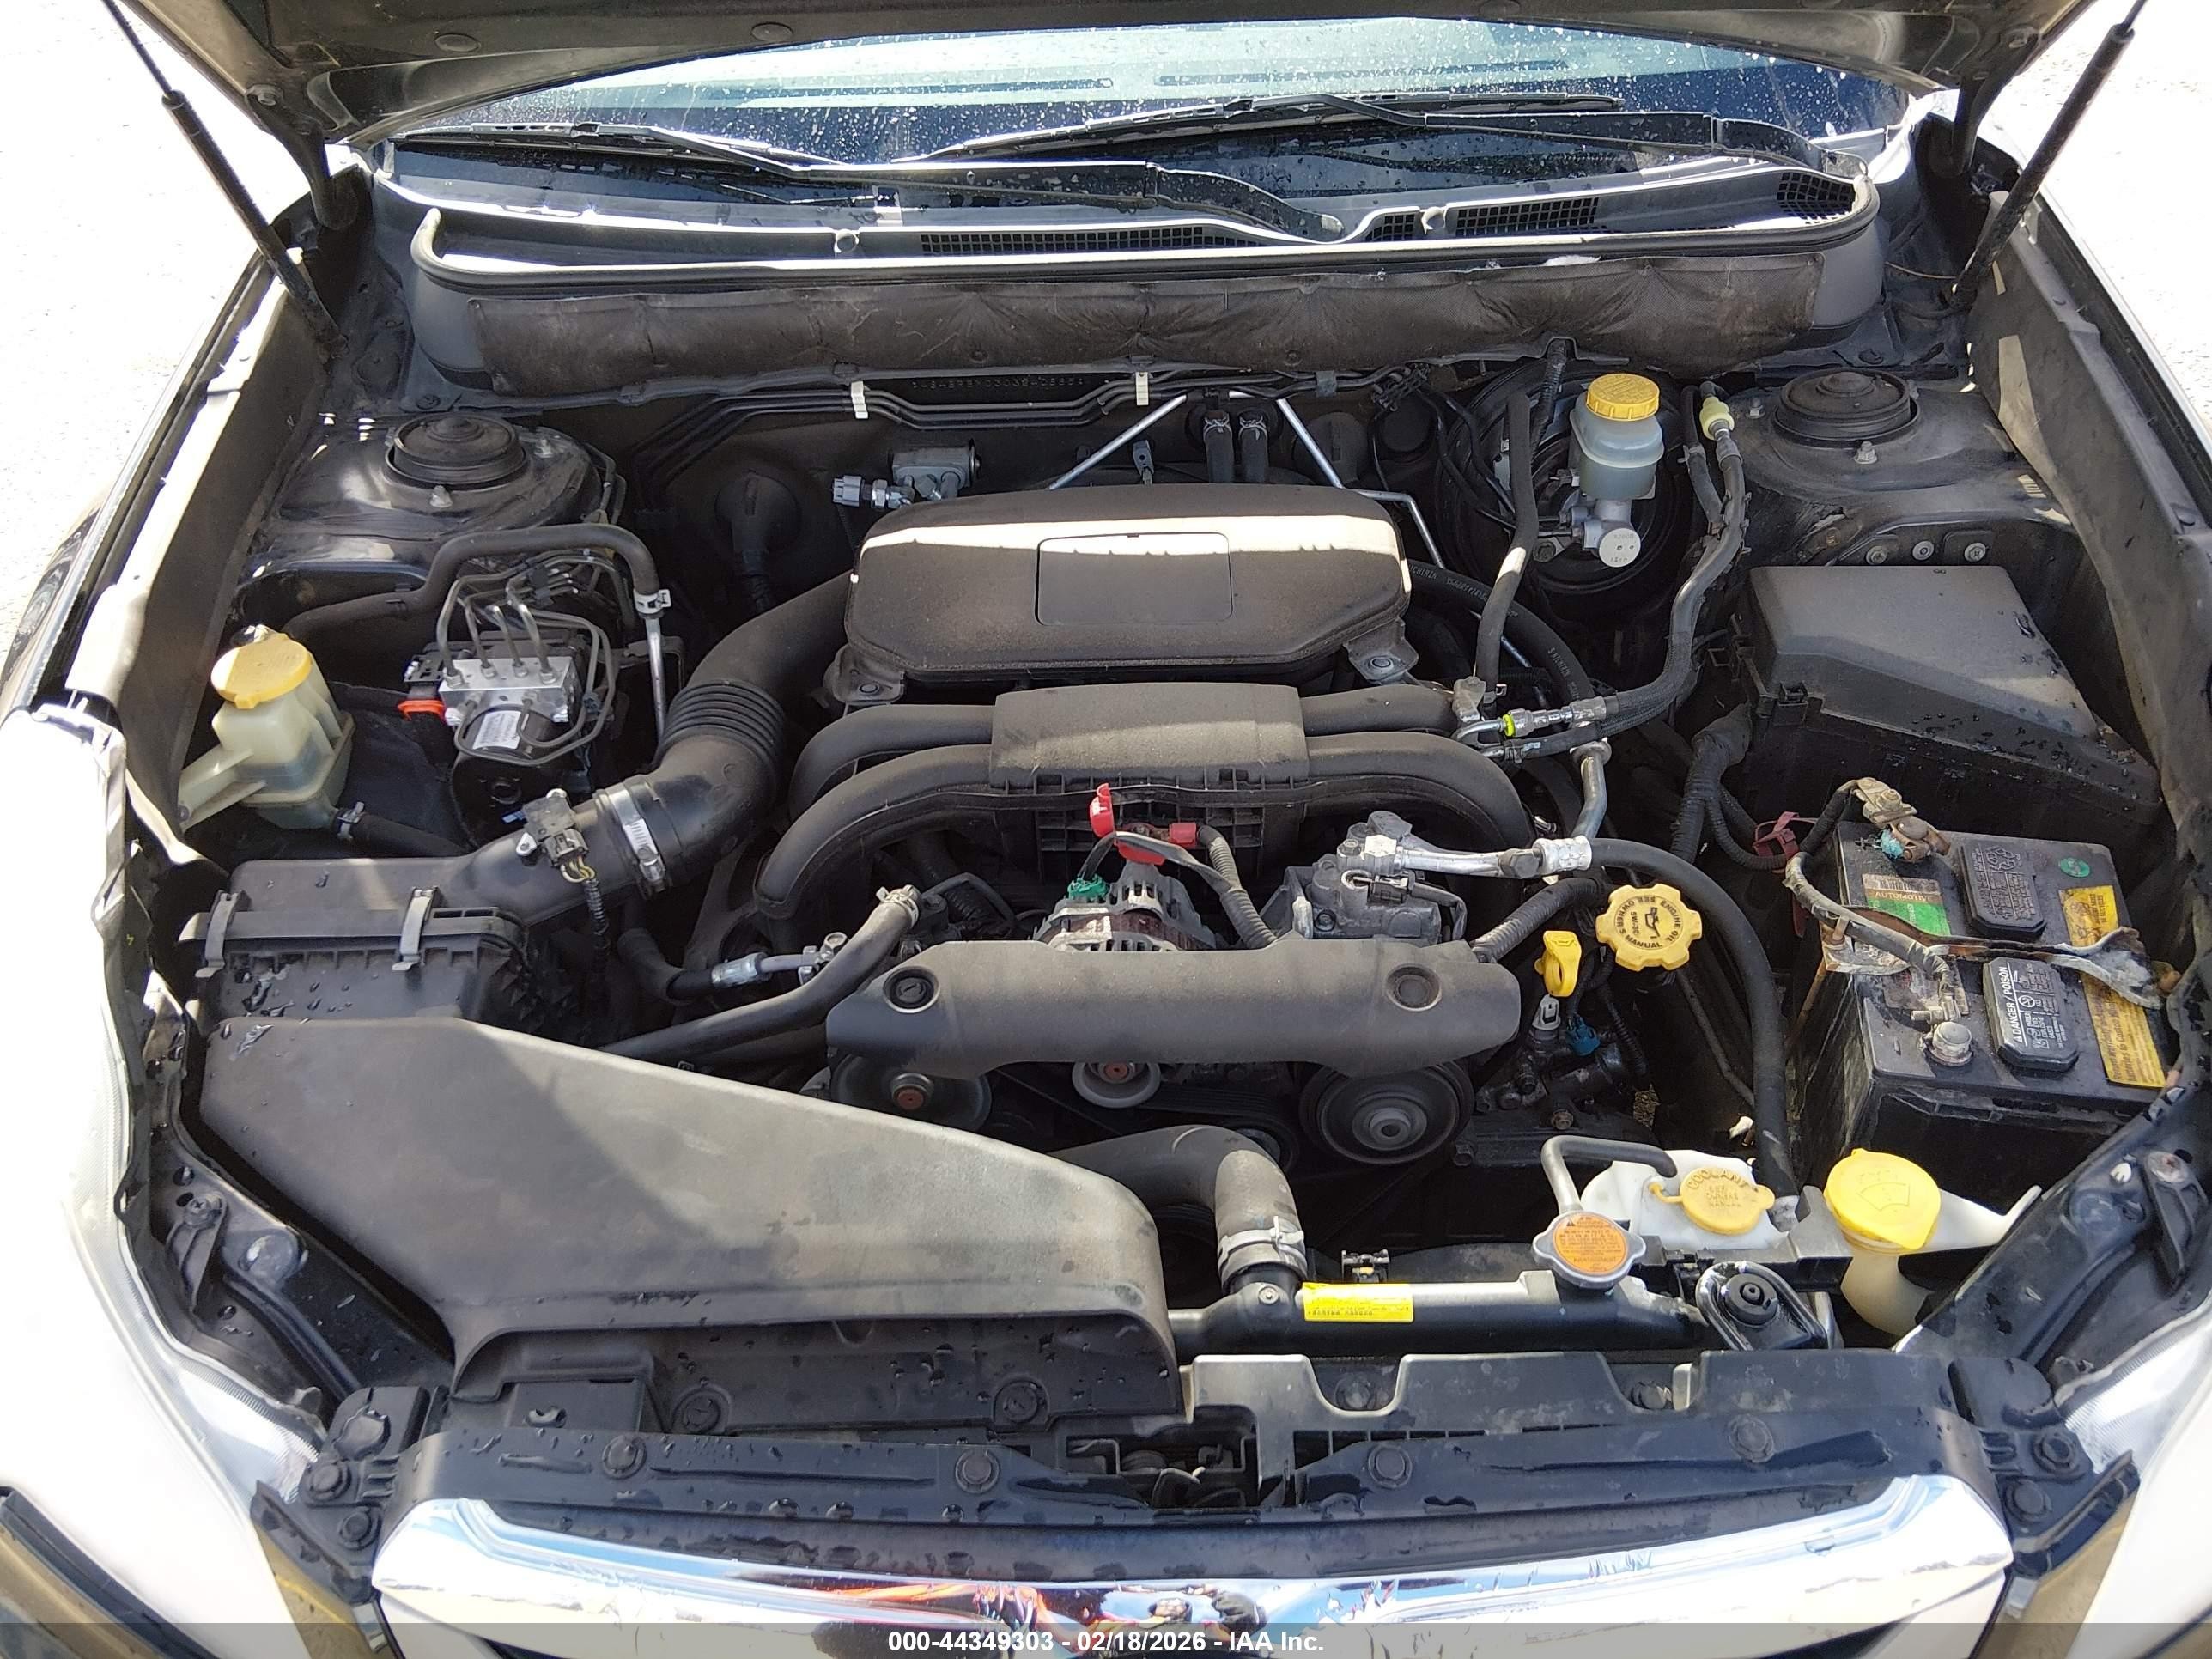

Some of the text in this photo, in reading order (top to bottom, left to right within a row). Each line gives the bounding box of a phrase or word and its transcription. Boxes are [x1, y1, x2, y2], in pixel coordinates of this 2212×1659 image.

[1660, 900, 1681, 943] ENGINE OIL
[1625, 934, 1662, 949] MANUAL
[1998, 966, 2014, 994] POISON
[2005, 1002, 2022, 1035] DANGER
[1686, 1169, 1749, 1190] COOLANT
